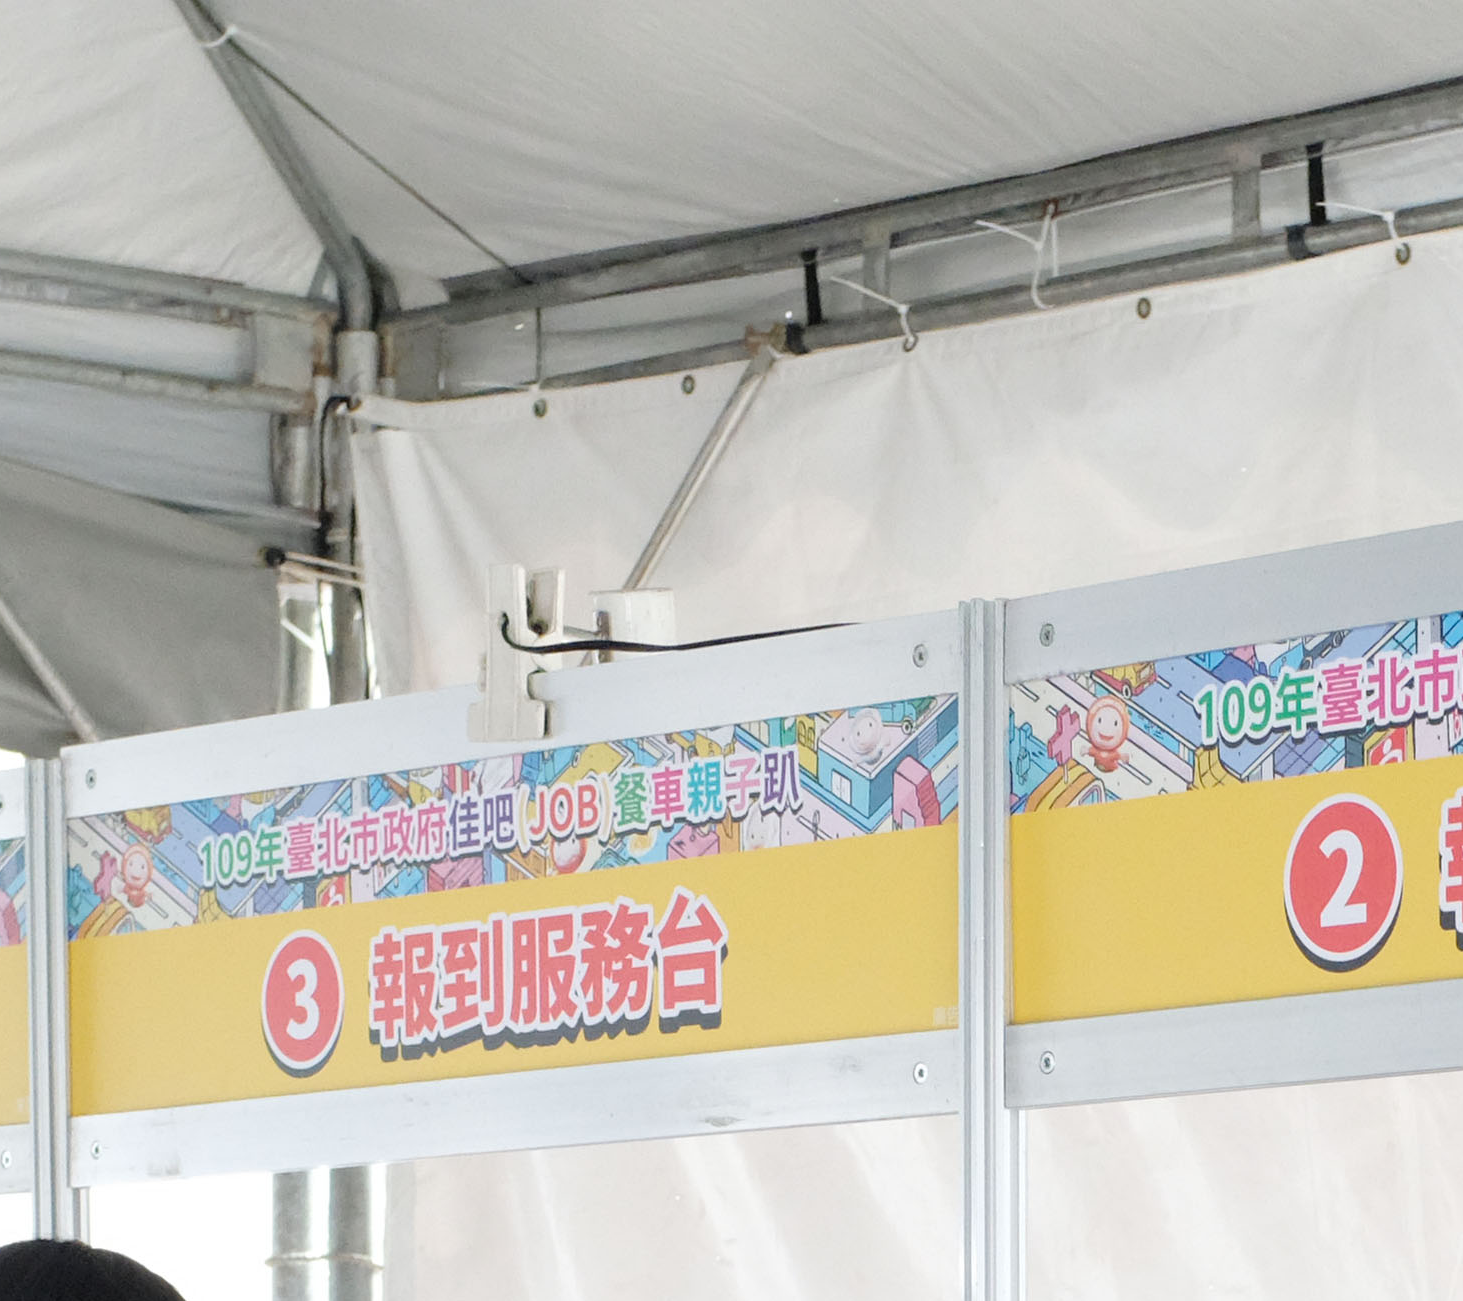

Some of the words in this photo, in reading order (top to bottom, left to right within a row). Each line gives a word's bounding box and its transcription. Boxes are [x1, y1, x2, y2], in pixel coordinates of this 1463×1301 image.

[199, 751, 801, 886] 109年臺北市政府佳吧(JOB)餐車親子趴
[371, 897, 724, 1043] 報到服務台
